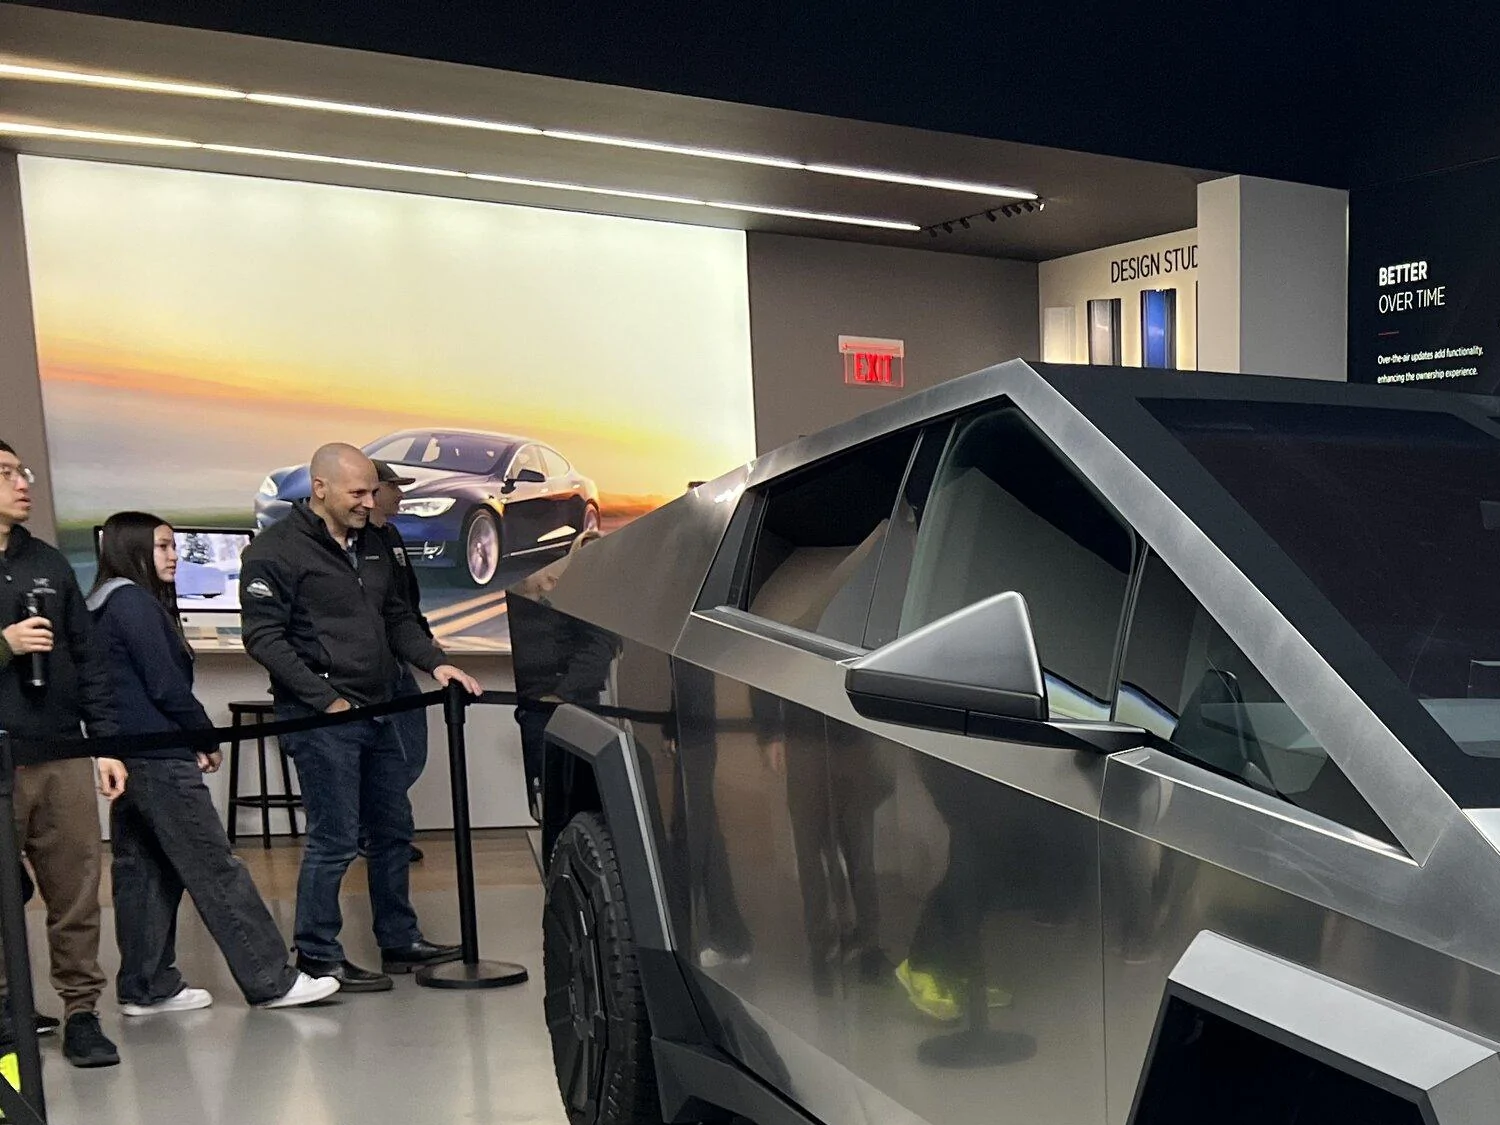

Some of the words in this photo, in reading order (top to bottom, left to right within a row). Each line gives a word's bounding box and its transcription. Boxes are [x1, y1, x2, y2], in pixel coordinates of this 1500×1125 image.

[1111, 252, 1160, 283] DESIGN
[1379, 261, 1428, 286] BETTER
[1378, 291, 1413, 314] OVER
[1416, 286, 1446, 308] TIME
[854, 352, 892, 383] EXIT
[1378, 353, 1410, 364] Over-the-air
[1411, 351, 1433, 362] updates
[1434, 348, 1446, 359] add
[1377, 373, 1404, 383] enhancing
[1405, 371, 1415, 381] the
[1416, 369, 1444, 380] ownership
